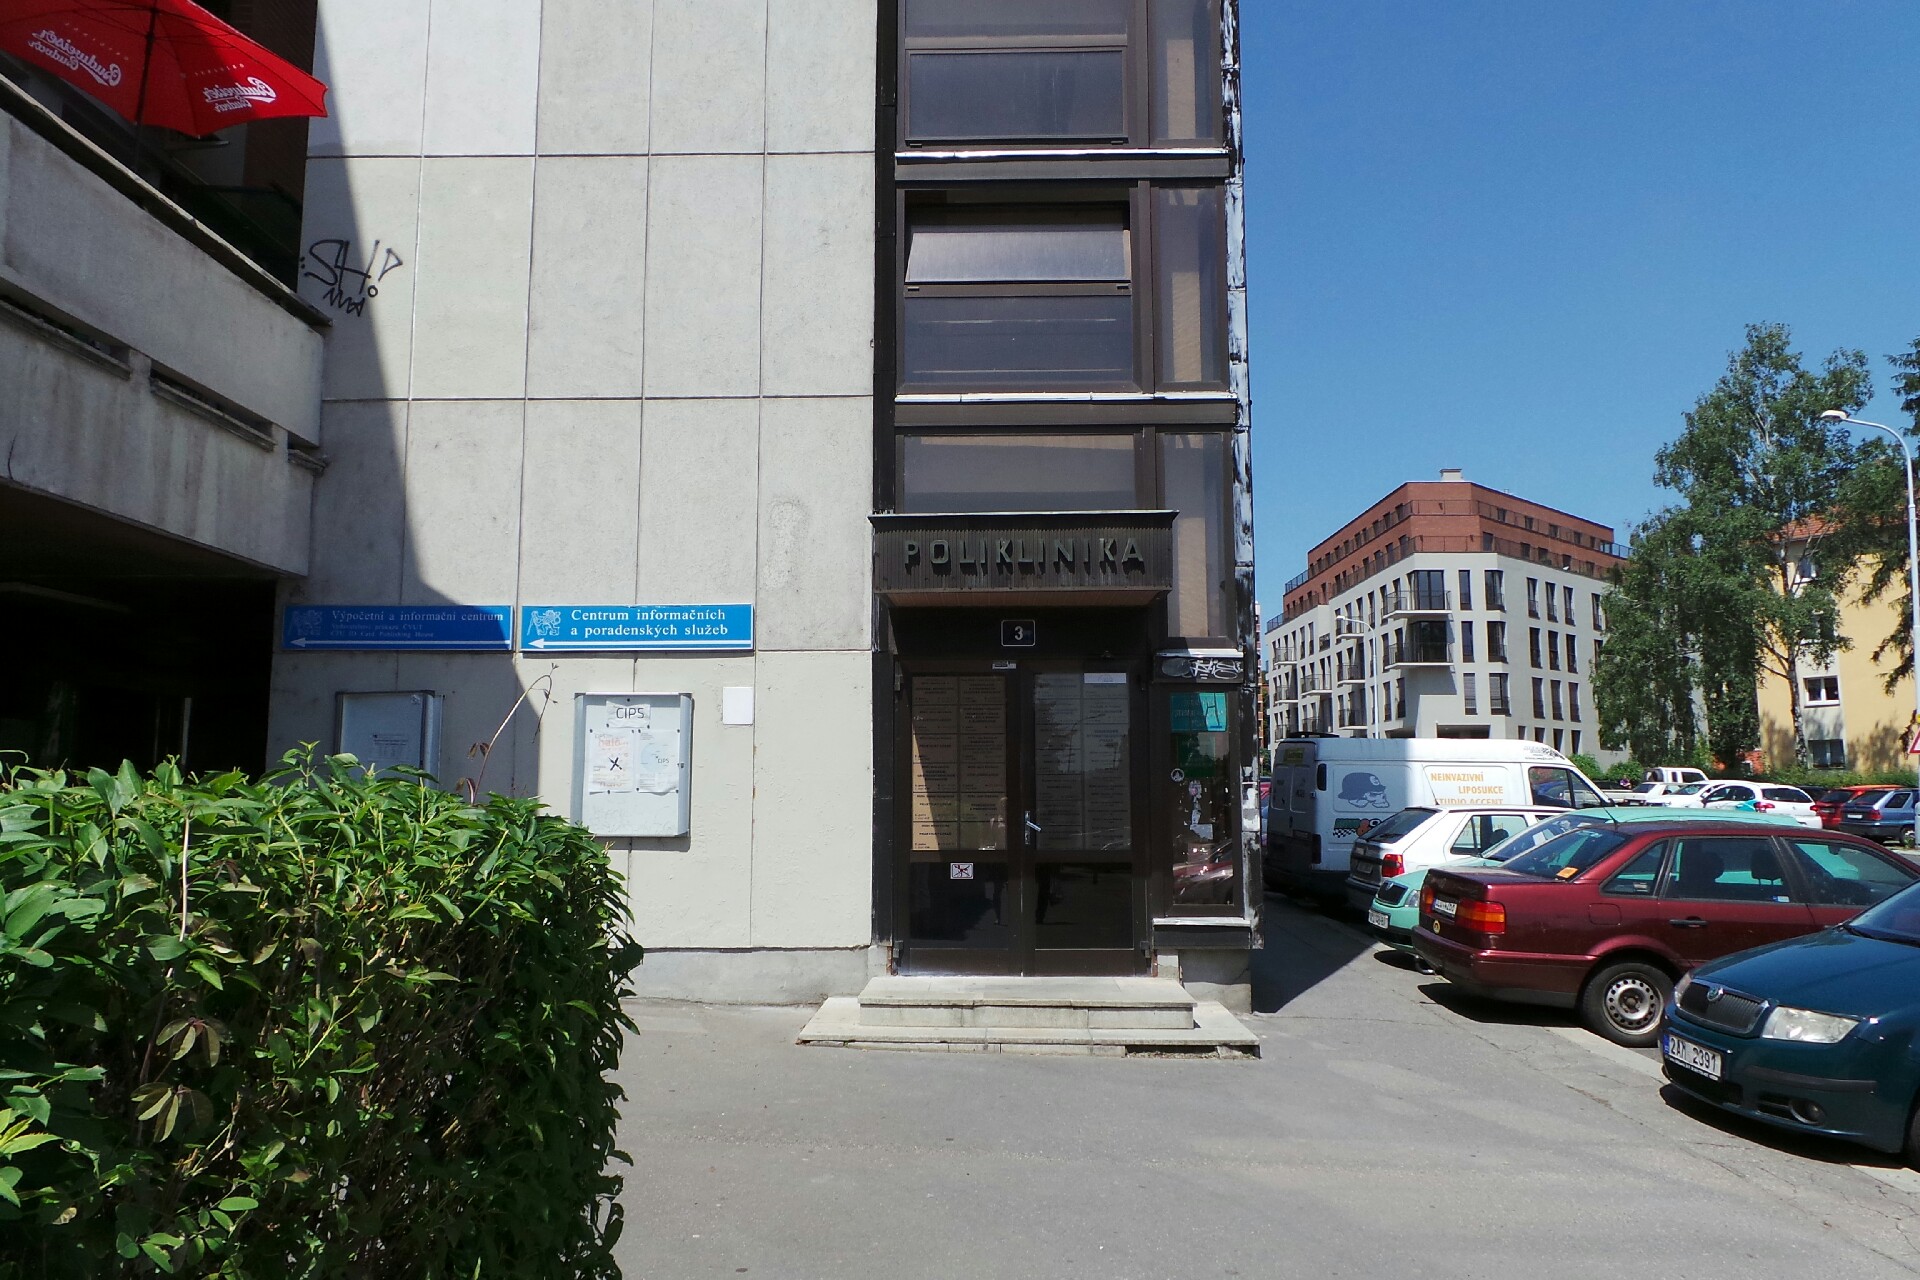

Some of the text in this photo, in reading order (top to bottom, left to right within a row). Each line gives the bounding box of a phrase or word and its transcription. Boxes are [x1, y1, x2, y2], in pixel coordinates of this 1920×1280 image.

[903, 537, 1144, 565] POLIKLINIKA
[389, 613, 395, 621] a
[461, 612, 504, 621] centrum
[571, 609, 726, 621] Centrum informačních
[570, 624, 728, 638] a poradenských služeb
[1014, 625, 1024, 641] 3
[616, 707, 645, 719] CIPS
[1430, 771, 1484, 782] NEINVAZIVNÍ
[1458, 786, 1504, 794] LIPOSUKCE
[1692, 1047, 1717, 1073] 2391
